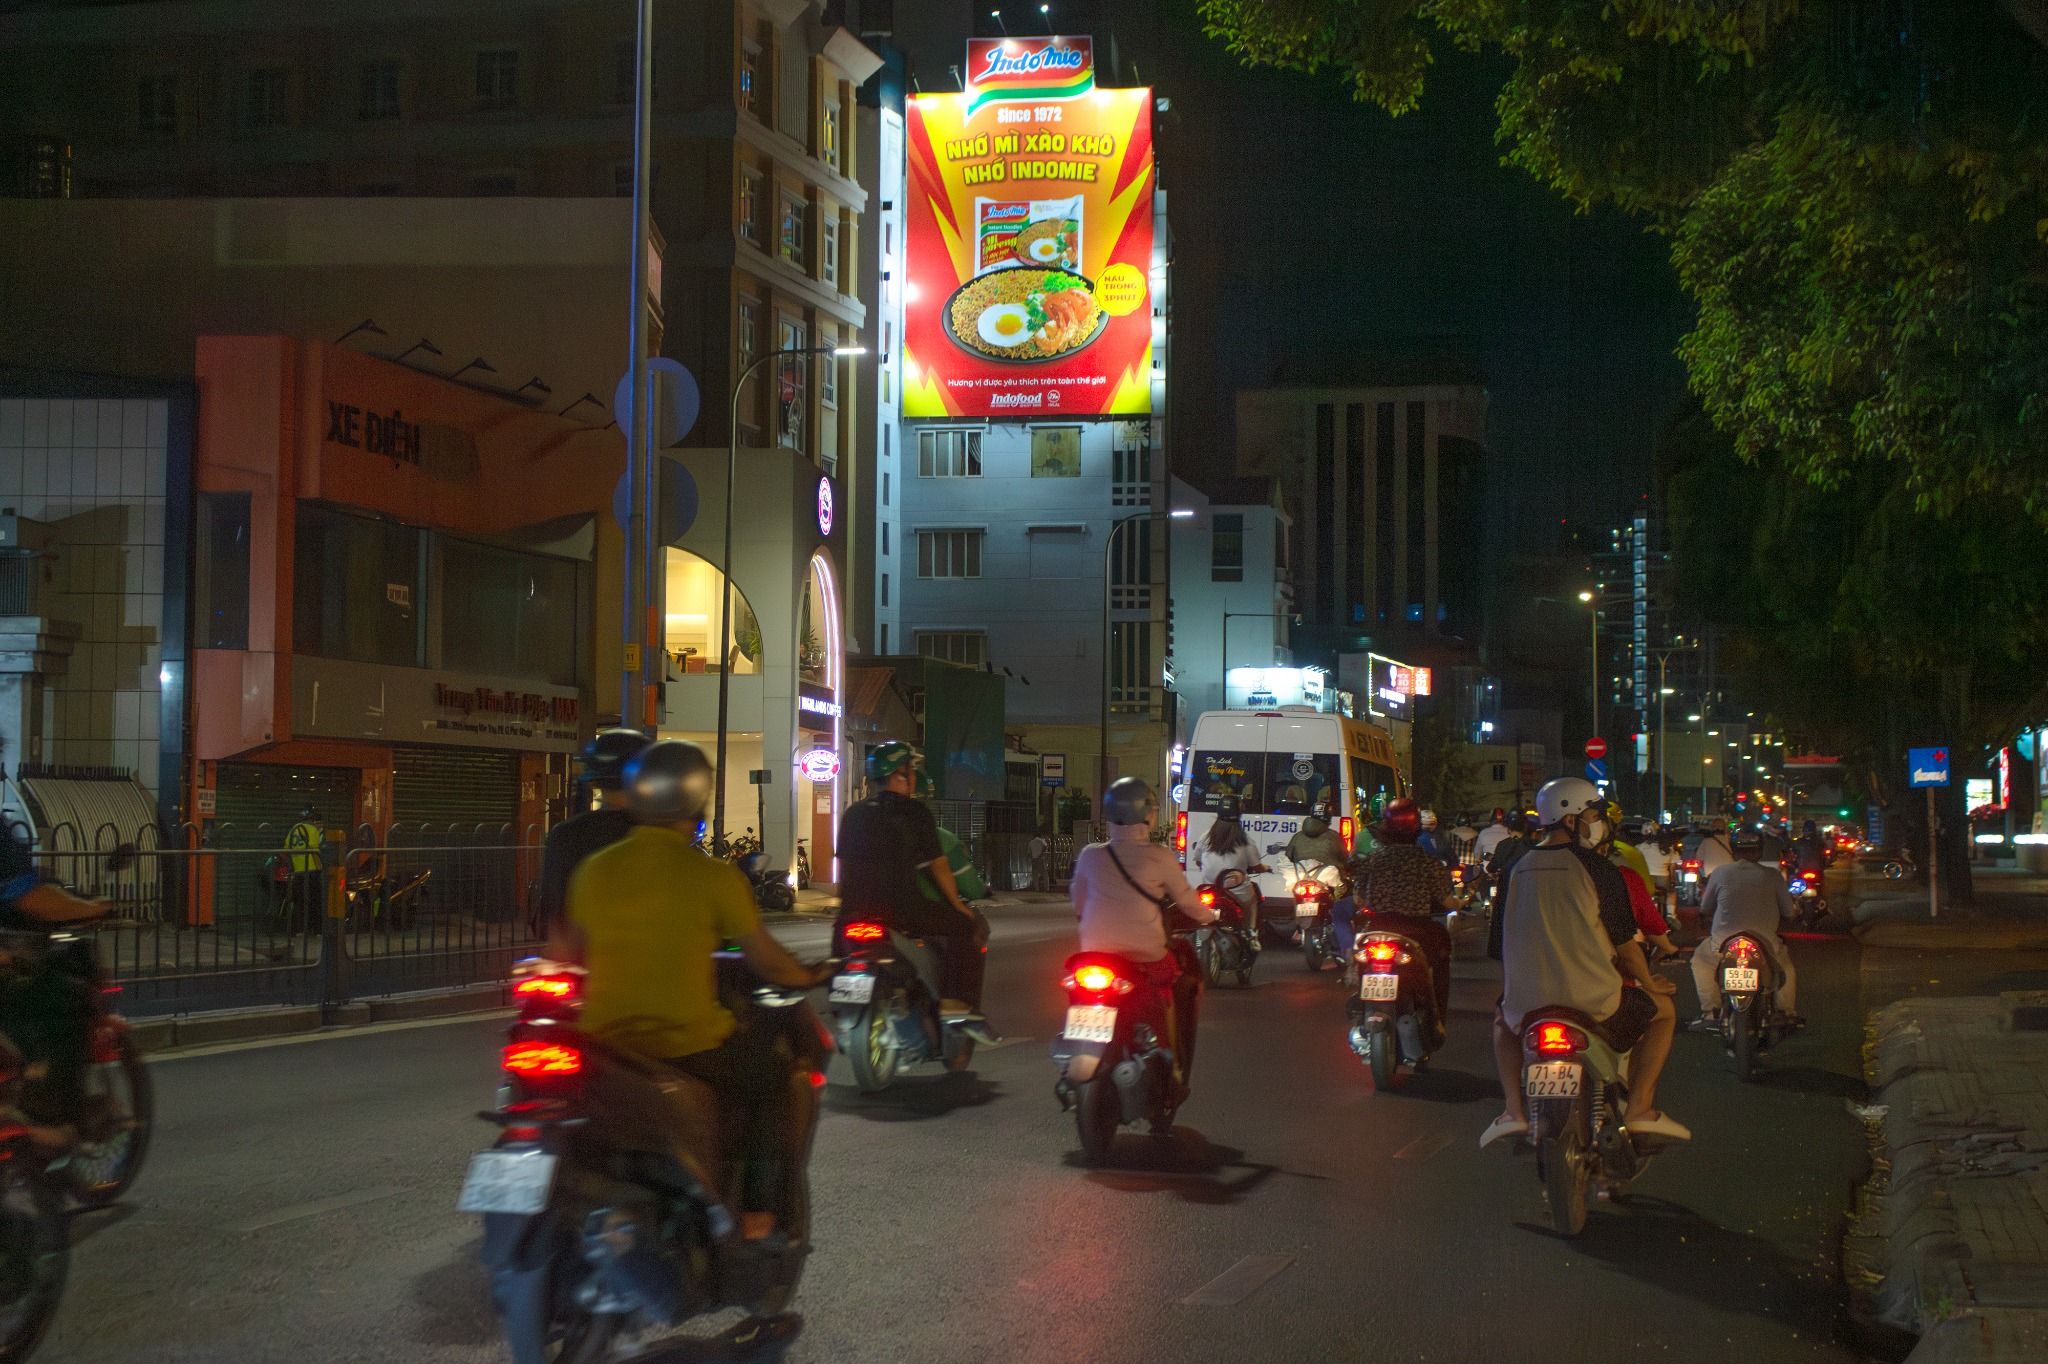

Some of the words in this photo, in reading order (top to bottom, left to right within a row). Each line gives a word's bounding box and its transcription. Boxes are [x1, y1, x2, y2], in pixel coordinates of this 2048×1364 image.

[997, 107, 1032, 123] Since
[1034, 107, 1062, 122] 1972
[946, 132, 988, 160] NHỚ
[995, 129, 1020, 155] MÌ
[1025, 128, 1066, 153] XÀO
[1071, 133, 1115, 156] KHÔ
[963, 158, 1006, 185] NHỚ
[1012, 160, 1098, 182] INDOMIE
[1019, 377, 1039, 386] thích
[1040, 377, 1056, 385] trên
[990, 392, 1043, 407] Indofood
[327, 400, 361, 448] XE
[1535, 1065, 1574, 1080] 71-B4
[1528, 1081, 1578, 1095] 022.42
